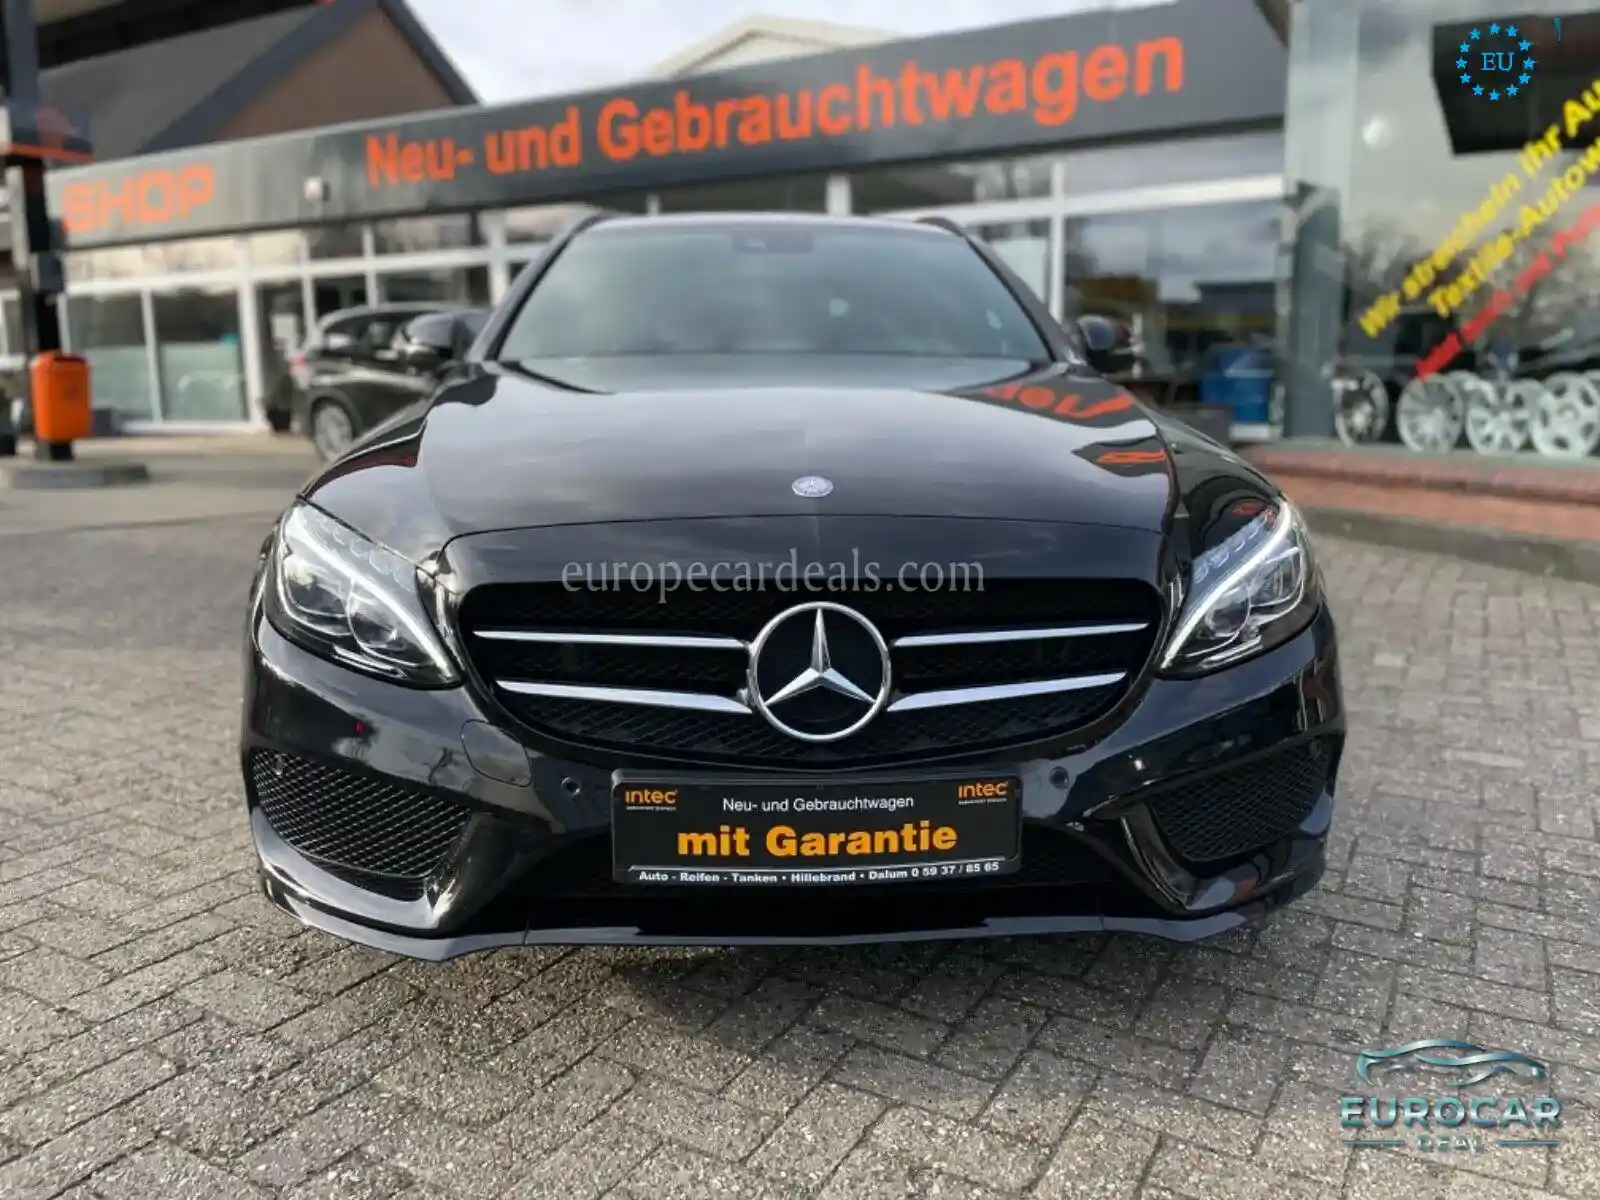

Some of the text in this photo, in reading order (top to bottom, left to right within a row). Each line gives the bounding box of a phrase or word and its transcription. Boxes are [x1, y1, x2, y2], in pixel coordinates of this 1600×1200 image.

[364, 34, 1186, 190] Neu- und Gebrauchtwagen
[61, 162, 216, 234] SHOP
[625, 789, 678, 804] intec
[958, 781, 1008, 798] intec
[723, 796, 915, 812] Neu- und Gebrauchtwagen
[677, 820, 958, 858] mit Garantie
[639, 870, 669, 882] Auto
[680, 872, 720, 882] Reifen
[732, 872, 778, 883] Tanken
[791, 871, 856, 883] Hillebrand
[868, 867, 908, 880] Dalum
[911, 867, 920, 877] 0
[941, 865, 956, 876] 37
